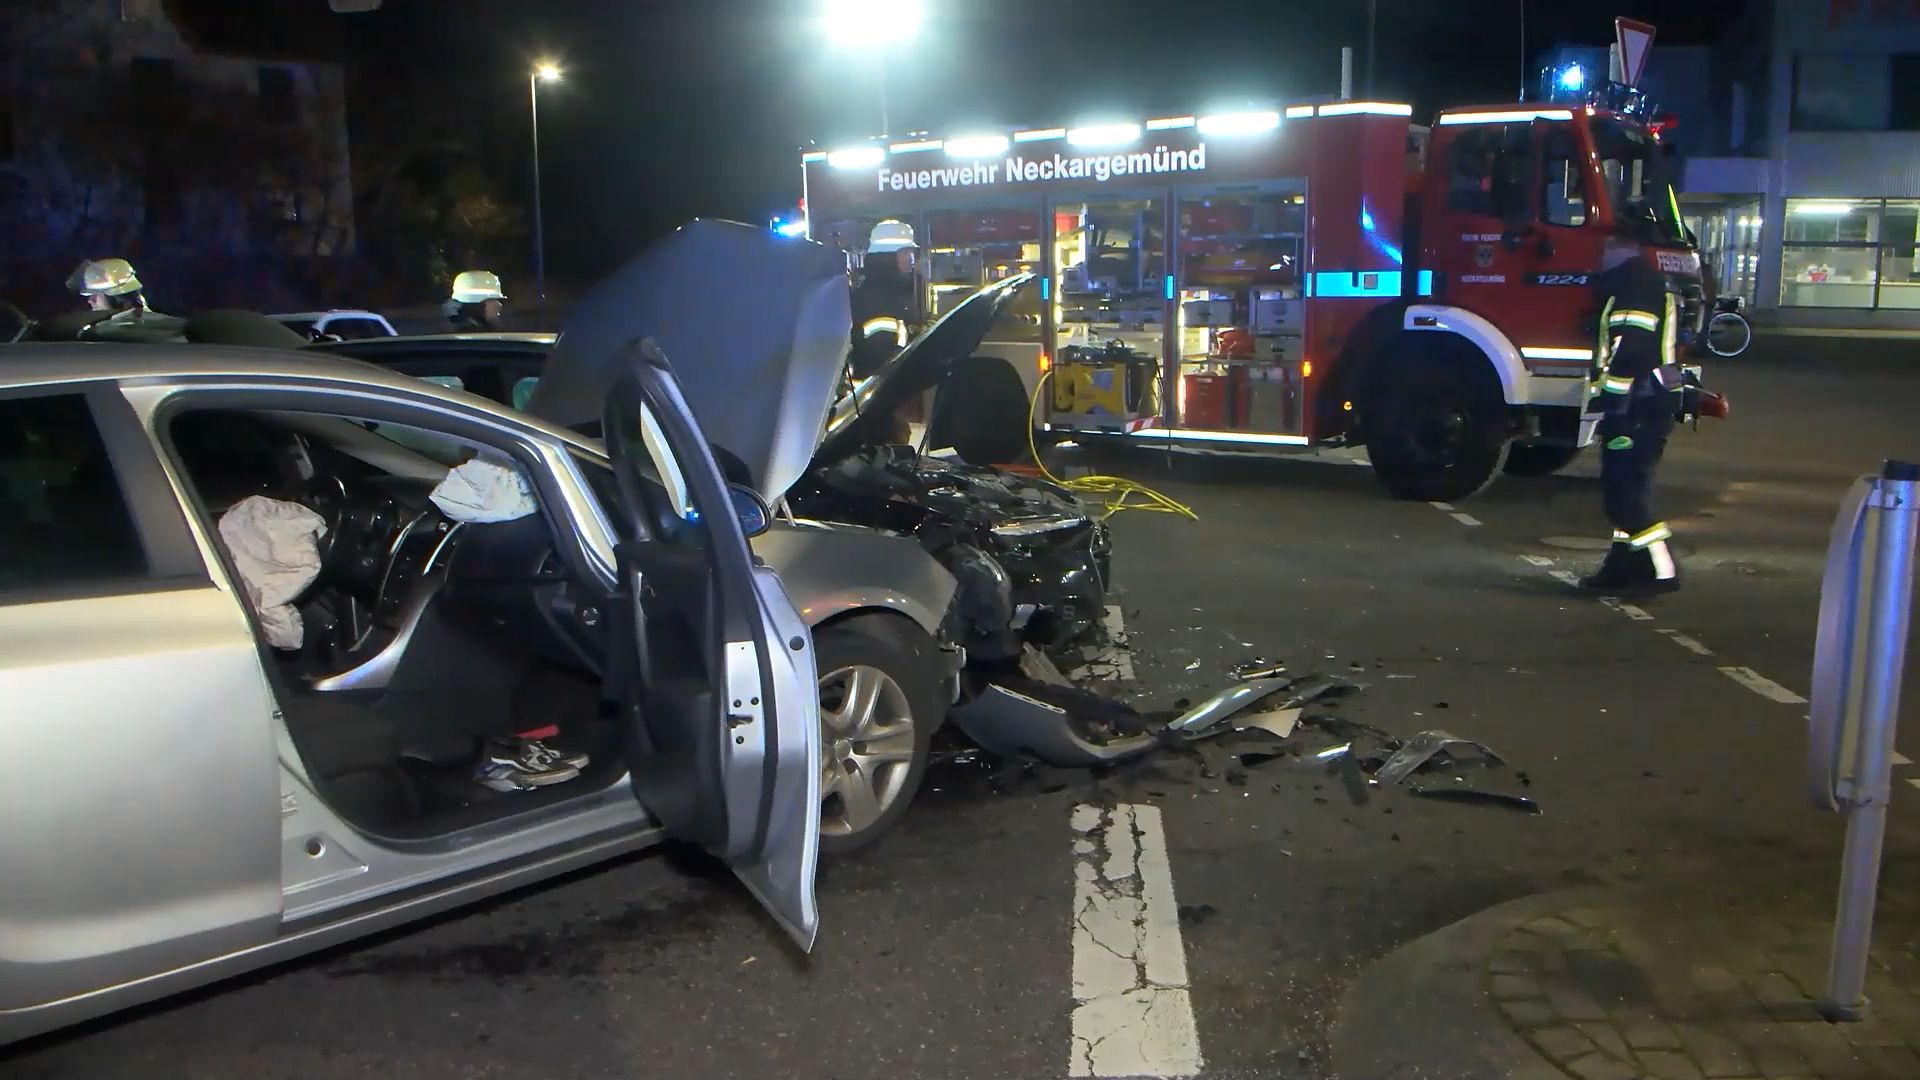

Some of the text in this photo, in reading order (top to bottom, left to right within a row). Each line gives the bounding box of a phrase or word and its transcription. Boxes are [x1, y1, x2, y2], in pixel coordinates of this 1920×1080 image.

[877, 142, 1207, 192] Feuerwehr Neckargemünd
[1537, 274, 1588, 285] 1224
